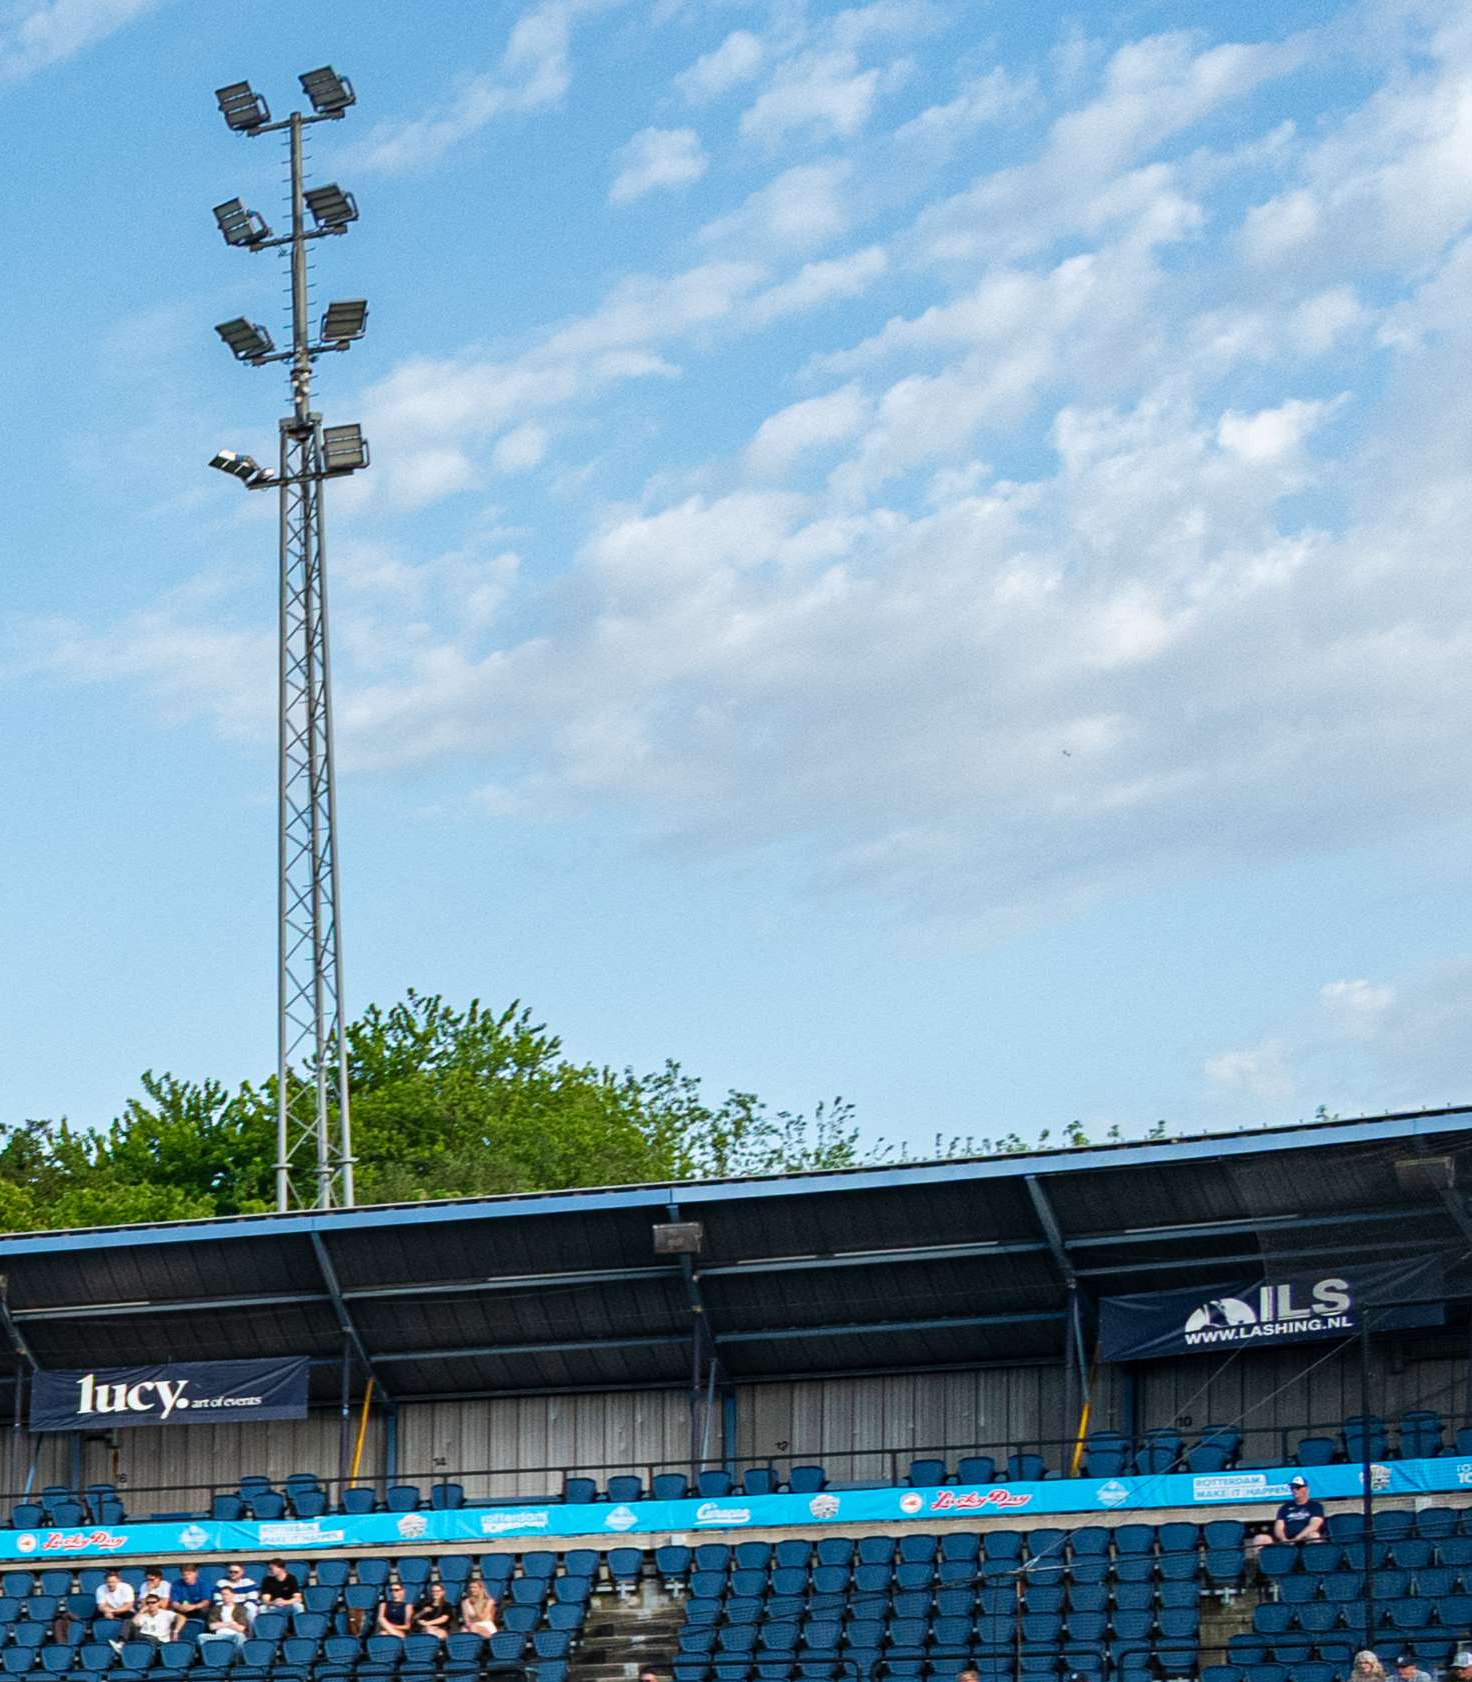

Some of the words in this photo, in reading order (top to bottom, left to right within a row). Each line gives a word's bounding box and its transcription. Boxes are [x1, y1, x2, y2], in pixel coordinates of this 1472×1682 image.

[1260, 1278, 1352, 1322] ILS
[1185, 1316, 1354, 1345] WWW.LASHING.NL
[931, 1491, 989, 1511] Lucky
[984, 1489, 1032, 1507] Day
[41, 1532, 91, 1551] Lucky
[87, 1531, 129, 1547] Day
